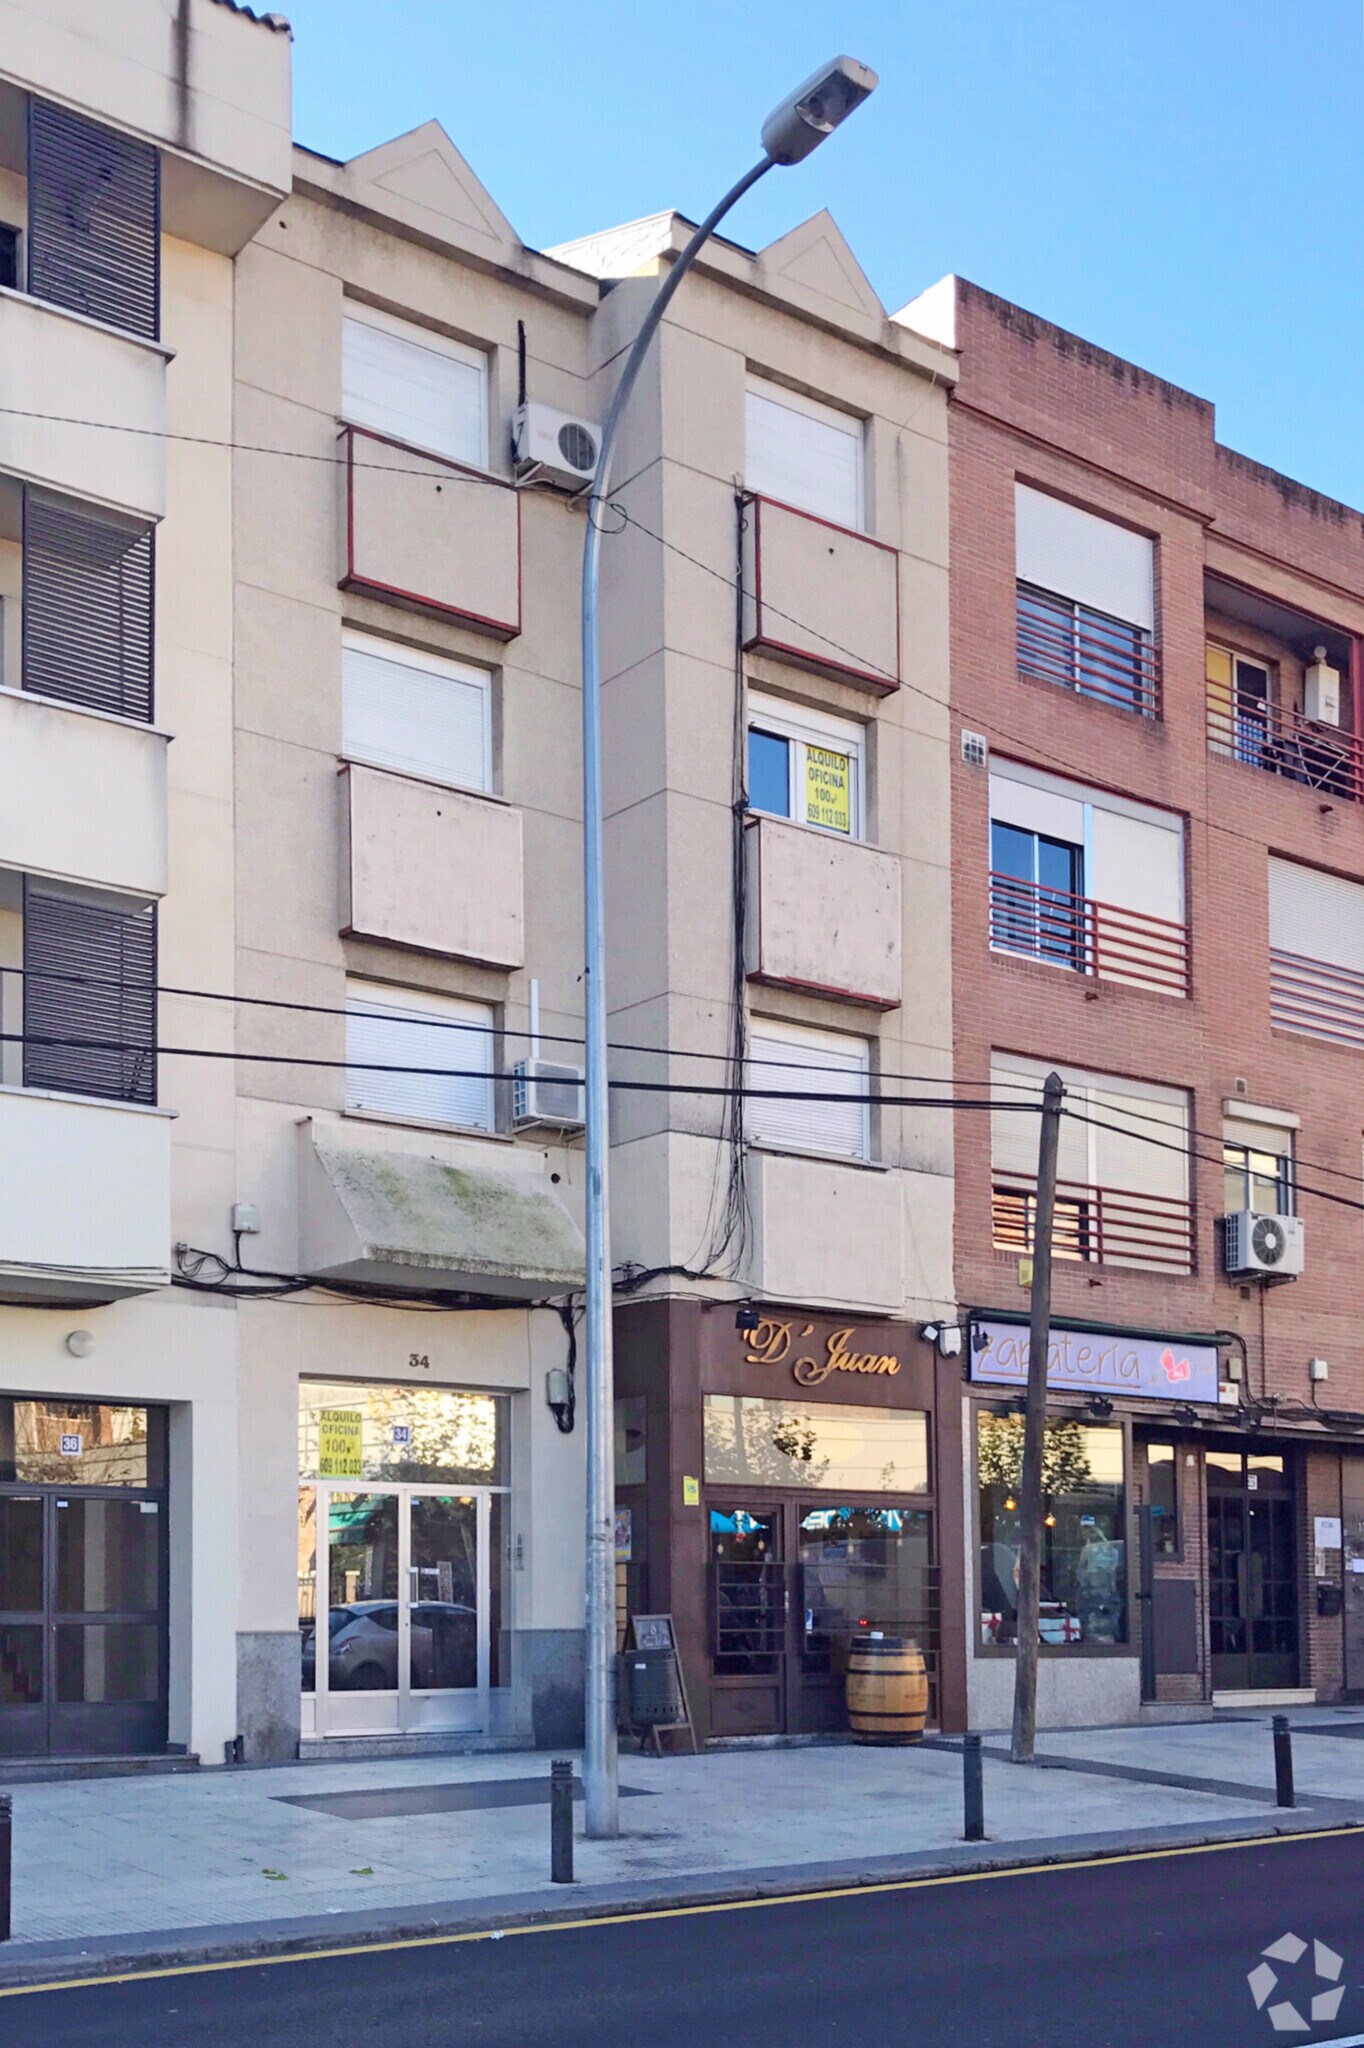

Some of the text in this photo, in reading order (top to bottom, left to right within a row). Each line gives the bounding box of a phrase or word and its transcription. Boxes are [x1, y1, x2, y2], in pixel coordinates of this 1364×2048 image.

[806, 748, 845, 771] ALQUILO
[808, 767, 845, 789] OFICINA
[807, 803, 846, 827] 609 112 033
[409, 1353, 430, 1369] 34
[320, 1410, 361, 1423] ALQUILO
[322, 1424, 360, 1436] OFICINA
[395, 1427, 407, 1440] 34
[63, 1437, 78, 1450] 36
[320, 1458, 361, 1475] 609 112 033
